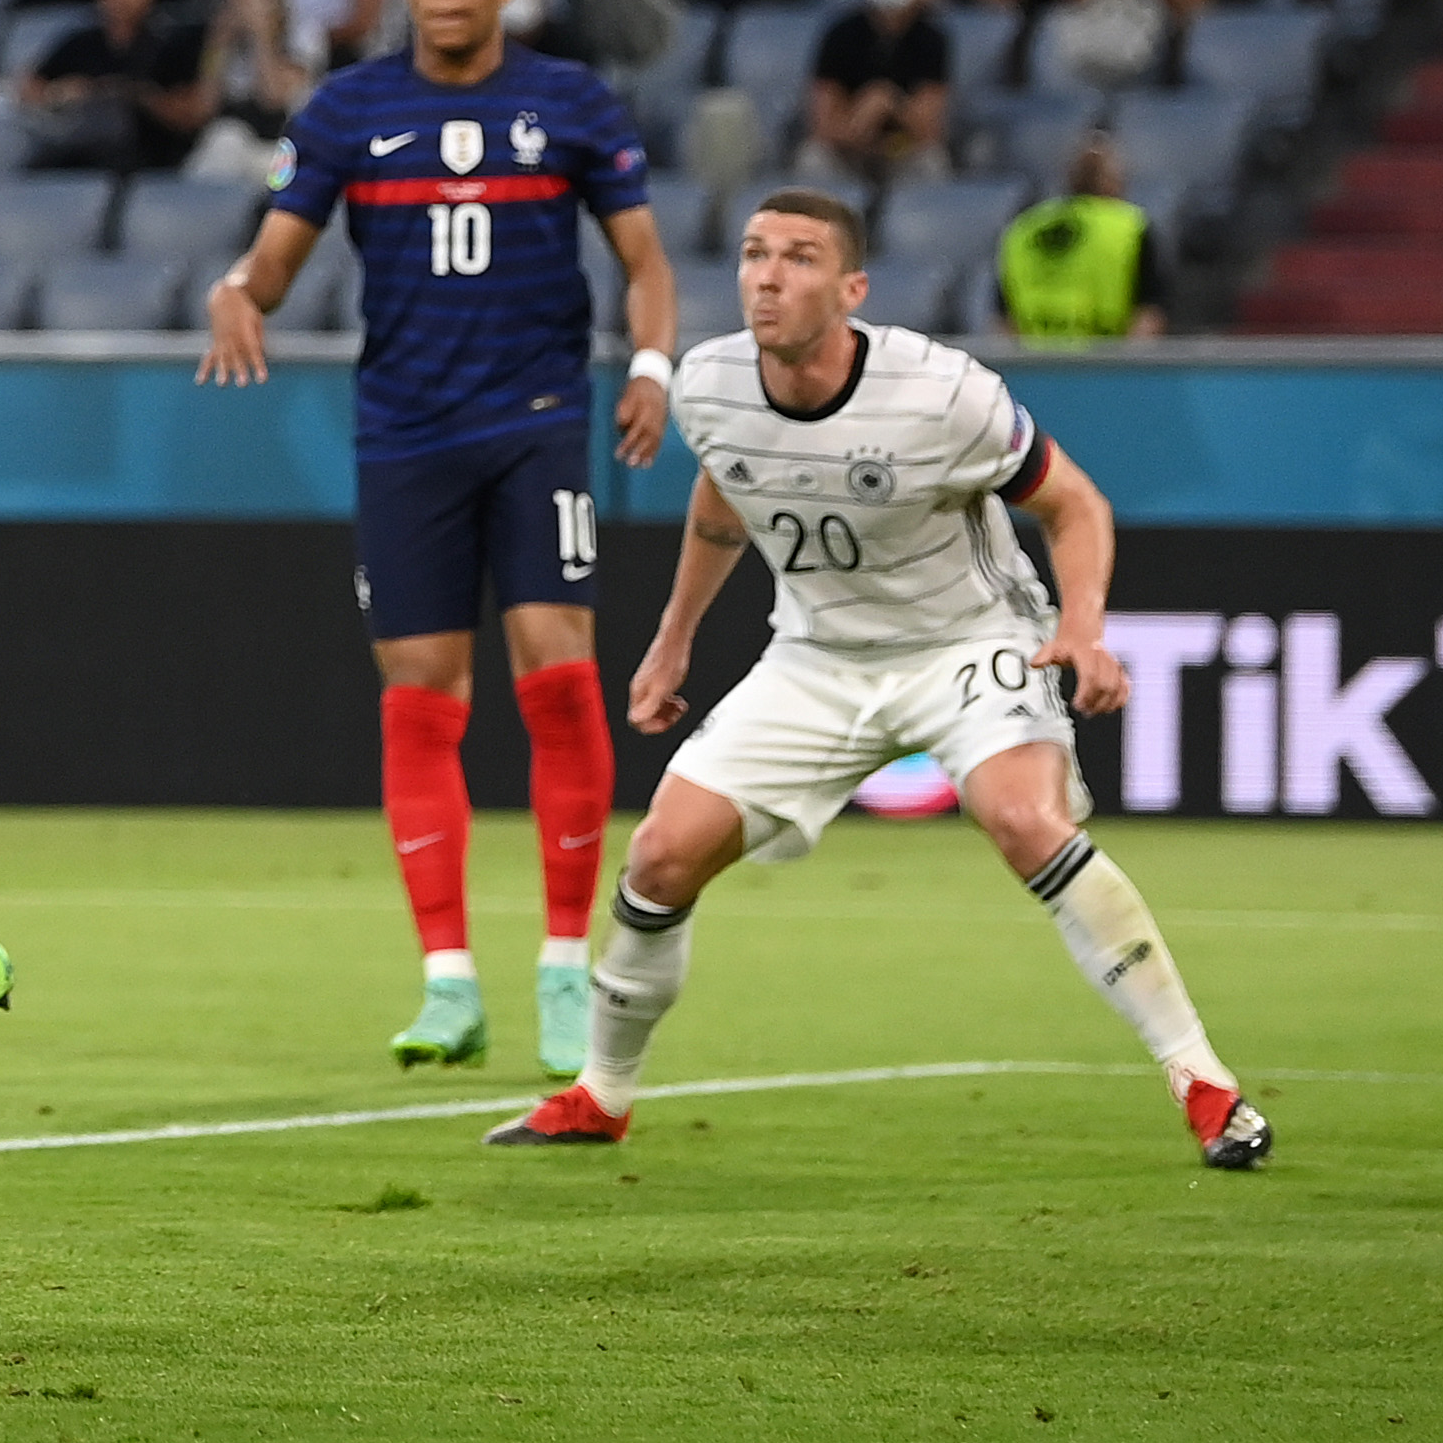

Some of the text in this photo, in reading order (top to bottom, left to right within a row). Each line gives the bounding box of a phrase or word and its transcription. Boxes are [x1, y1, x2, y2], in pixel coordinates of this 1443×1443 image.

[427, 202, 492, 276] 10
[552, 488, 597, 564] 10
[770, 512, 862, 573] 20
[953, 647, 1028, 710] 20
[1104, 609, 1443, 816] Tik
